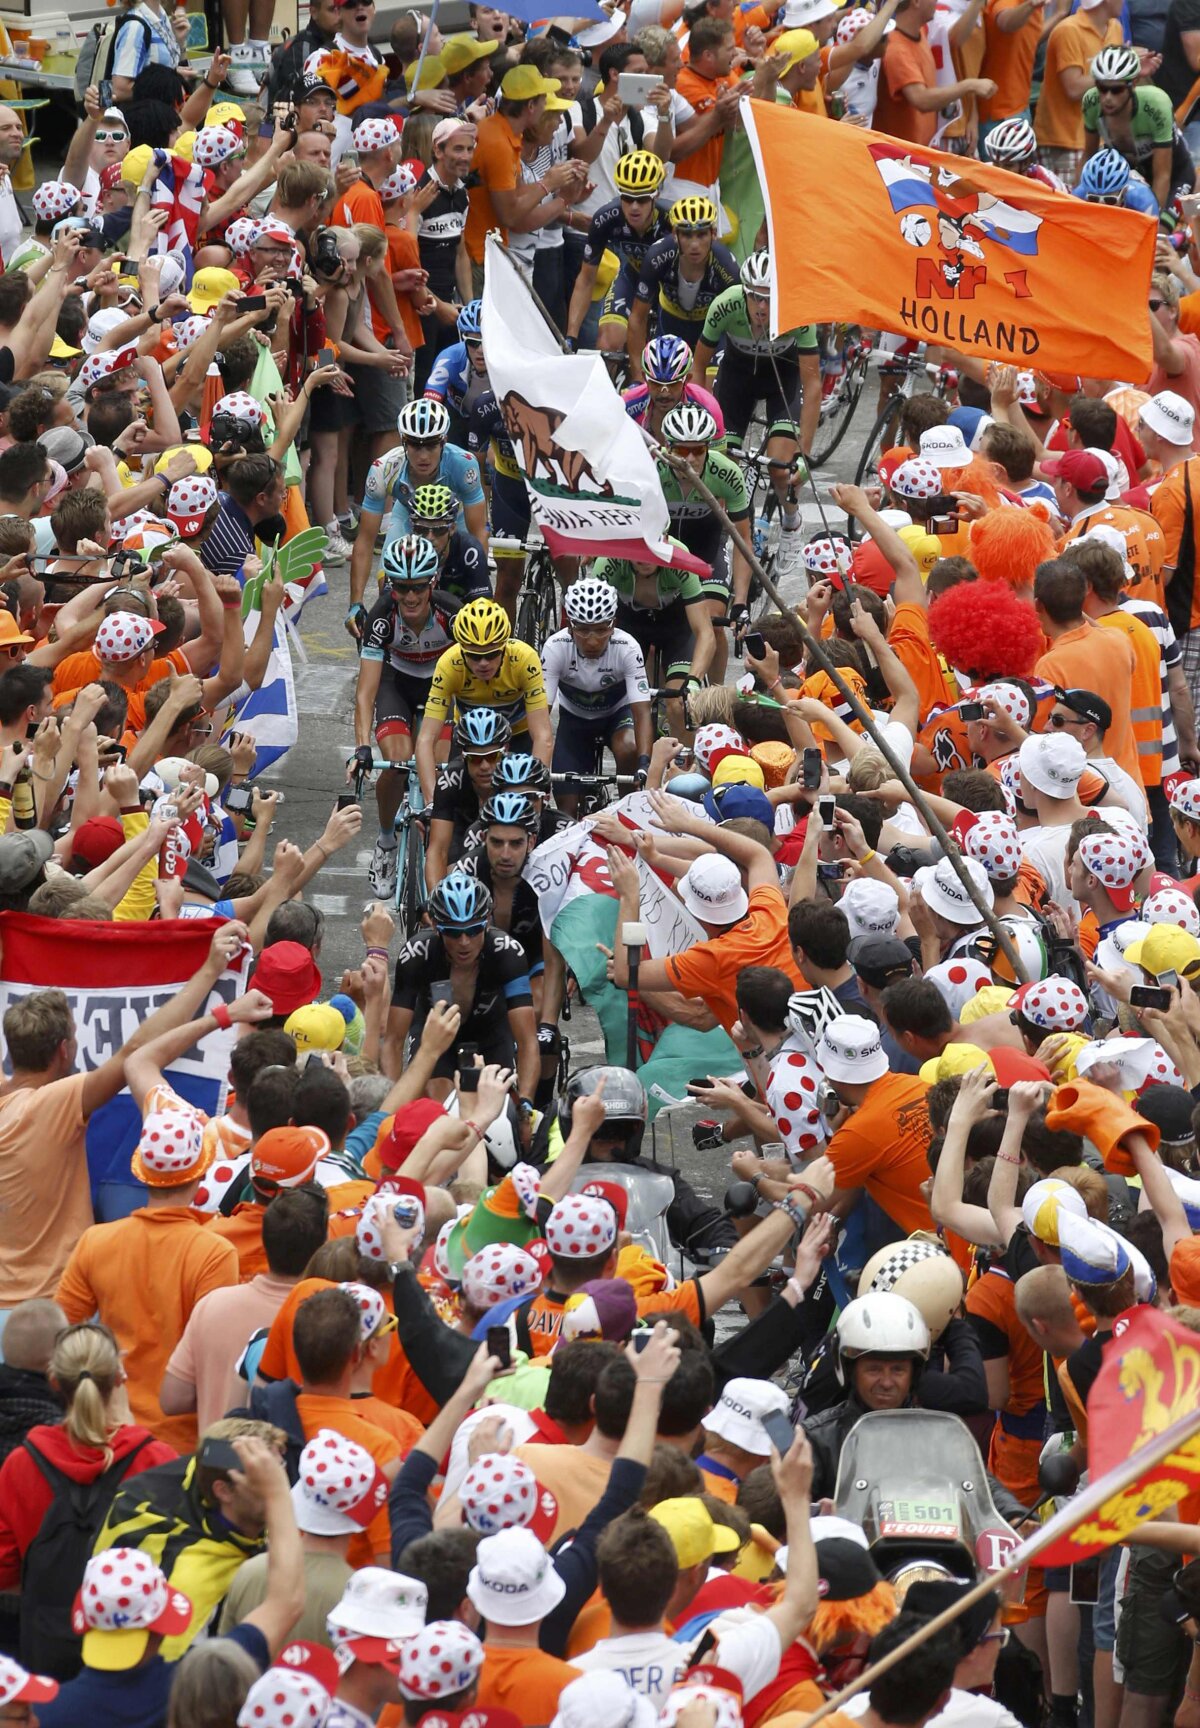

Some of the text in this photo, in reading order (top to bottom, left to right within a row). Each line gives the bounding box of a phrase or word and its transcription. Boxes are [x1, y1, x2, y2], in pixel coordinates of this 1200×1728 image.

[594, 208, 619, 229] SAXO
[651, 249, 676, 269] SAXO
[1004, 269, 1033, 298] 1
[708, 299, 742, 329] belkin
[900, 297, 1040, 355] HOLLAND
[477, 401, 498, 417] SAX
[710, 461, 744, 496] belkin
[437, 769, 464, 791] sky
[690, 884, 713, 903] ODA
[399, 938, 431, 964] sky
[494, 935, 525, 957] sky
[914, 1505, 953, 1521] 501
[882, 1522, 957, 1536] L'EQUIPE
